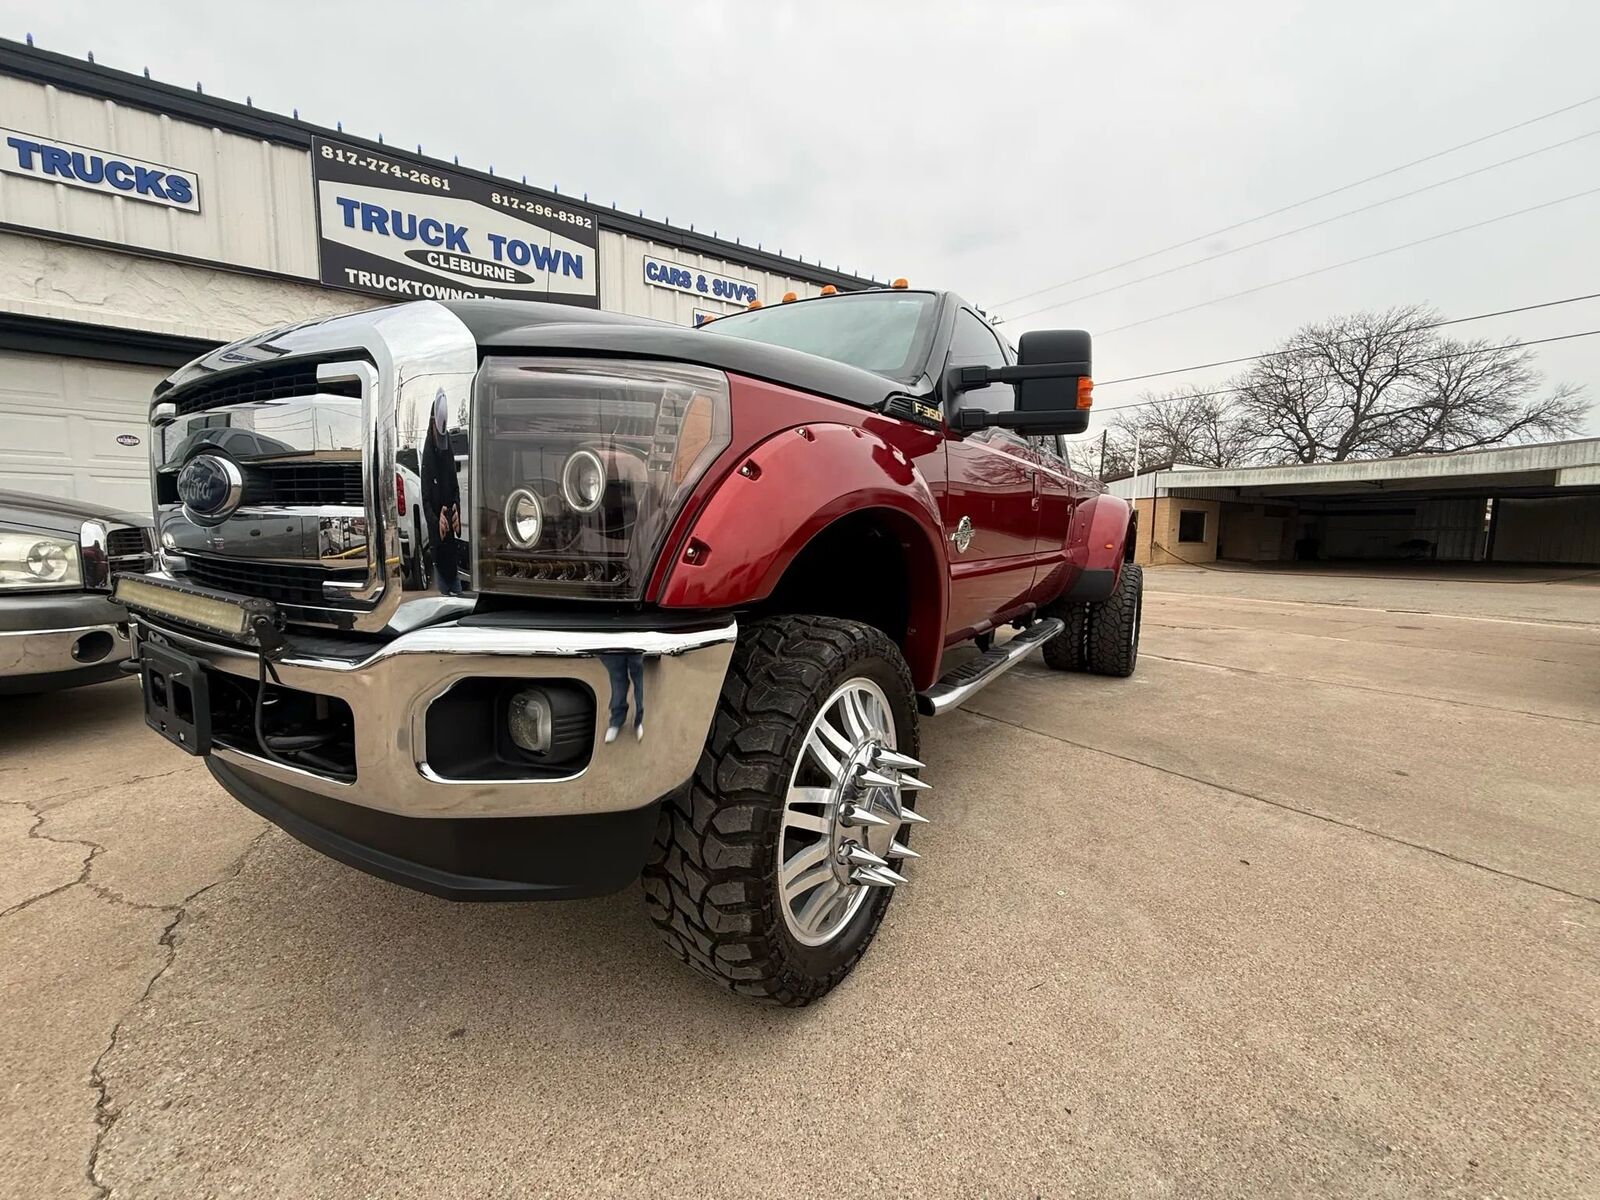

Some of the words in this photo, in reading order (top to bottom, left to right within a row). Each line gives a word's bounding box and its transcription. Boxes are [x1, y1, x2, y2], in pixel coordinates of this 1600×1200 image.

[7, 136, 193, 203] TRUCKS
[321, 145, 451, 191] 817-774-2661
[491, 192, 592, 229] 817-296-8382
[336, 197, 470, 253] TRUCK
[487, 233, 584, 280] TOWN
[344, 268, 502, 301] TRUCKTOWNC
[427, 253, 515, 282] CLEBURNE
[646, 262, 692, 288] CARS
[696, 275, 708, 293] &
[713, 279, 756, 301] SUV'S
[181, 465, 213, 501] Ford
